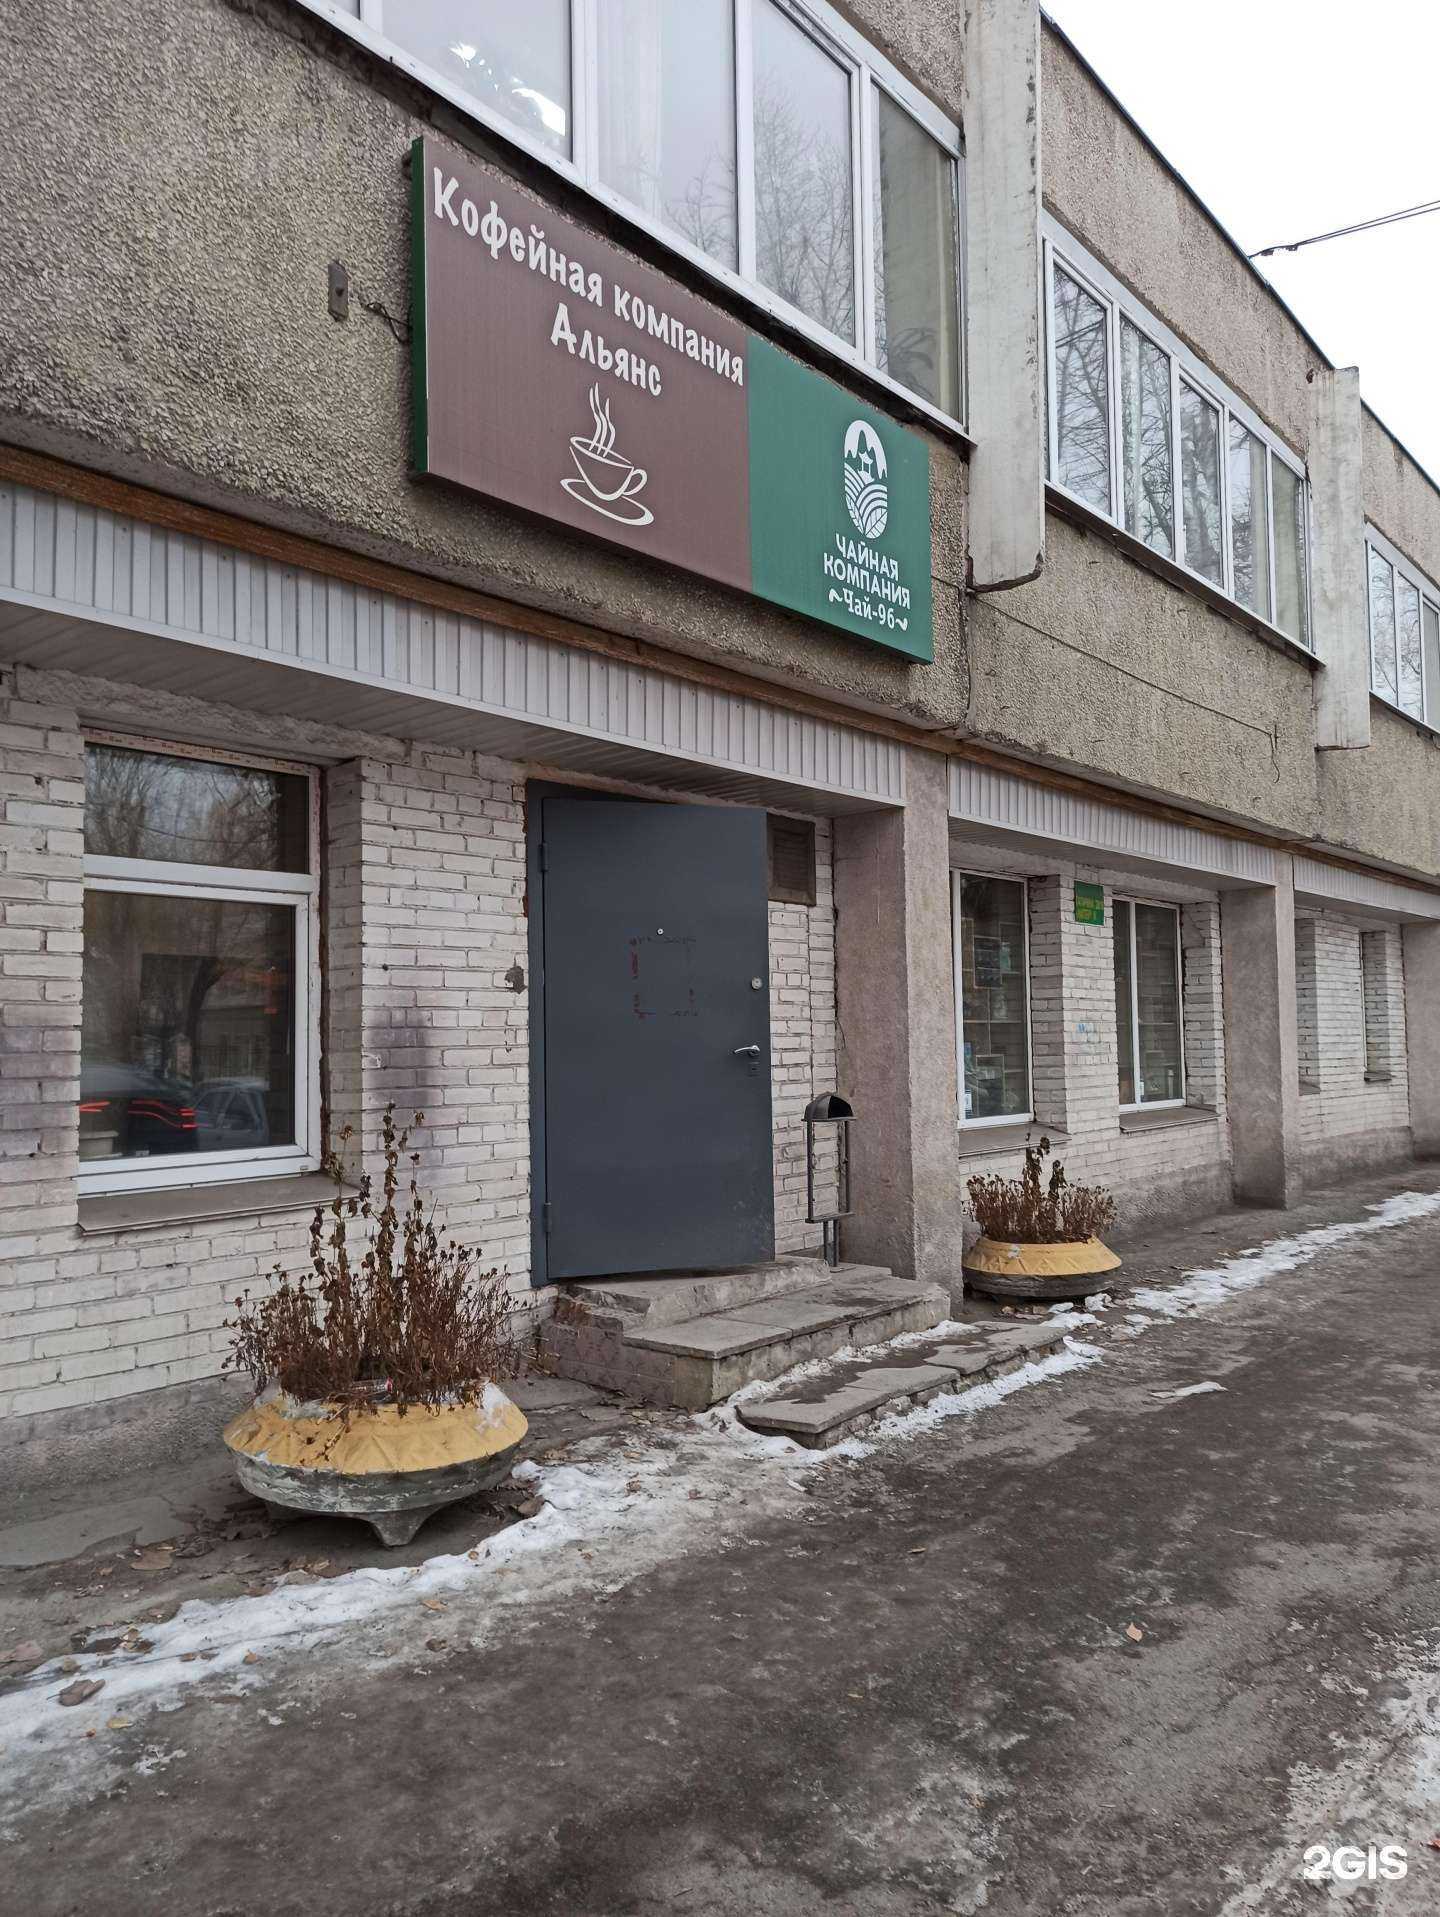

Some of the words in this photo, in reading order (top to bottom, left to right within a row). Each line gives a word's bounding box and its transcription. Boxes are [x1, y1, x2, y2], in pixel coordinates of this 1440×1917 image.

[433, 167, 602, 306] Кофейная
[614, 285, 743, 386] компания
[550, 302, 662, 396] Альянс
[823, 552, 910, 609] КОМПАНИЯ
[835, 533, 898, 581] ЧАЙНАЯ
